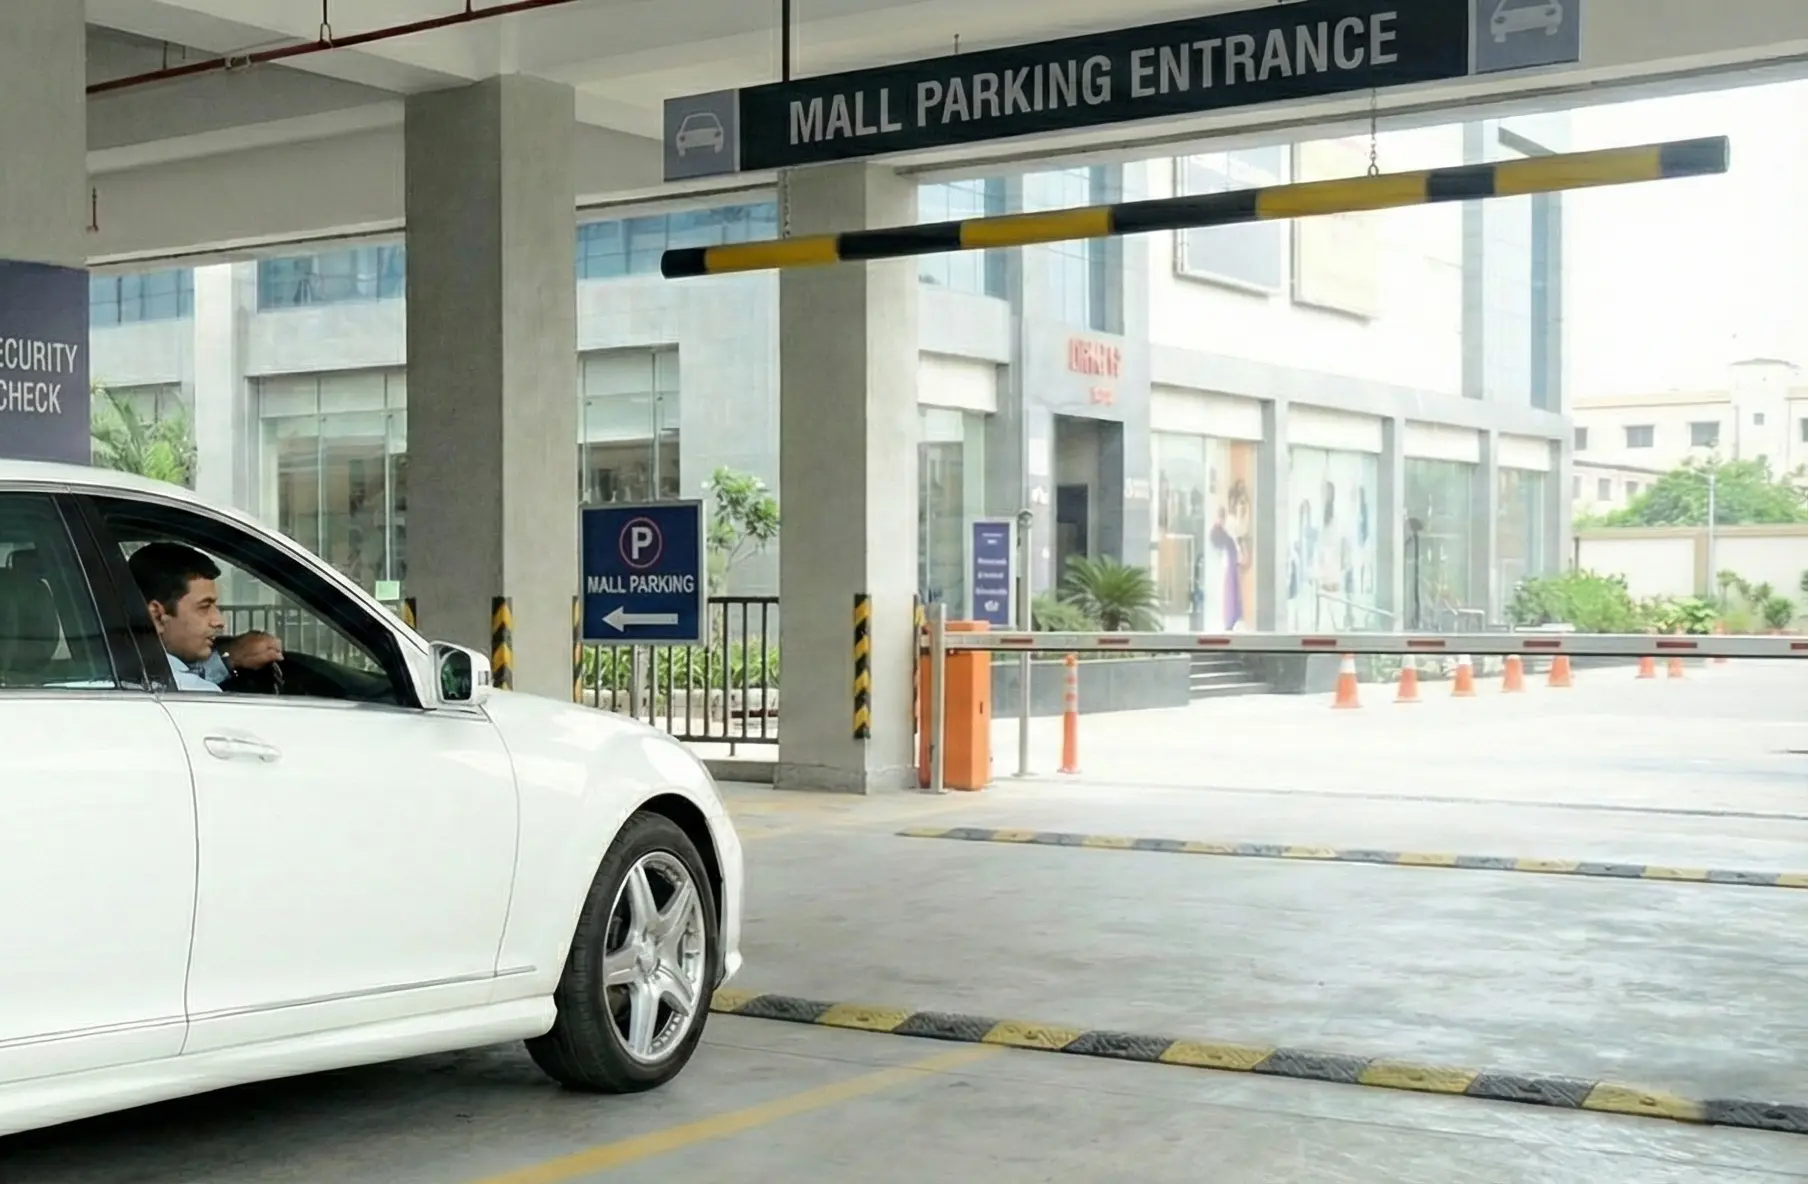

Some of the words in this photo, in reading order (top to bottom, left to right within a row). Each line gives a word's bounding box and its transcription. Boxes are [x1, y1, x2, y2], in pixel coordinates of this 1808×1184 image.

[790, 87, 902, 145] MALL
[917, 54, 1112, 127] PARKING
[1130, 10, 1398, 99] ENTRANCE
[631, 526, 653, 559] P
[587, 576, 627, 594] MALL
[629, 574, 695, 594] PARKING
